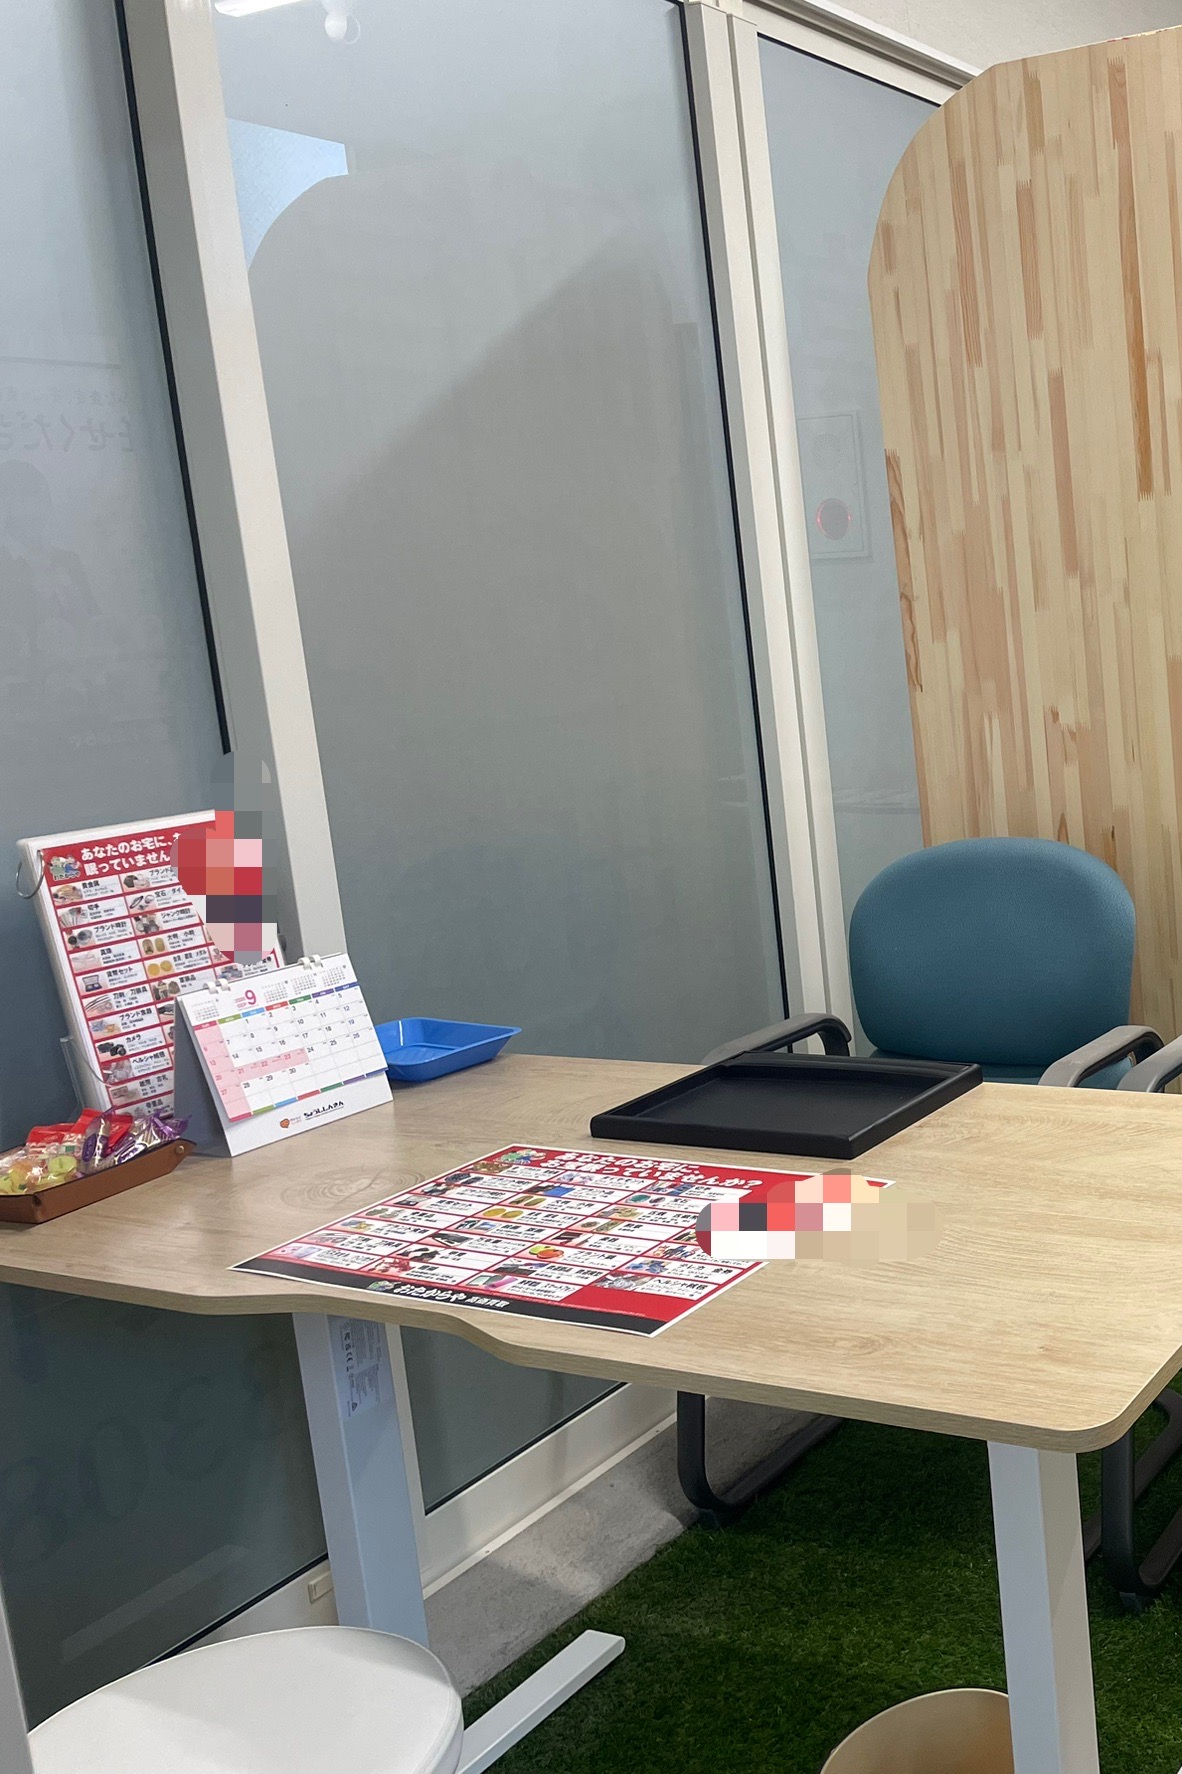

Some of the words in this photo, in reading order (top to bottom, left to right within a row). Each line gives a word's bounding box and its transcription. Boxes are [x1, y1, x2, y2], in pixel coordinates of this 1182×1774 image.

[93, 920, 127, 933] ブランド時計
[245, 989, 257, 1006] 9
[348, 1018, 355, 1026] 19
[125, 1033, 142, 1043] カメラ
[243, 1081, 250, 1089] 28
[266, 1074, 273, 1082] 29
[289, 1067, 297, 1075] 30
[393, 1284, 467, 1302] おたからや
